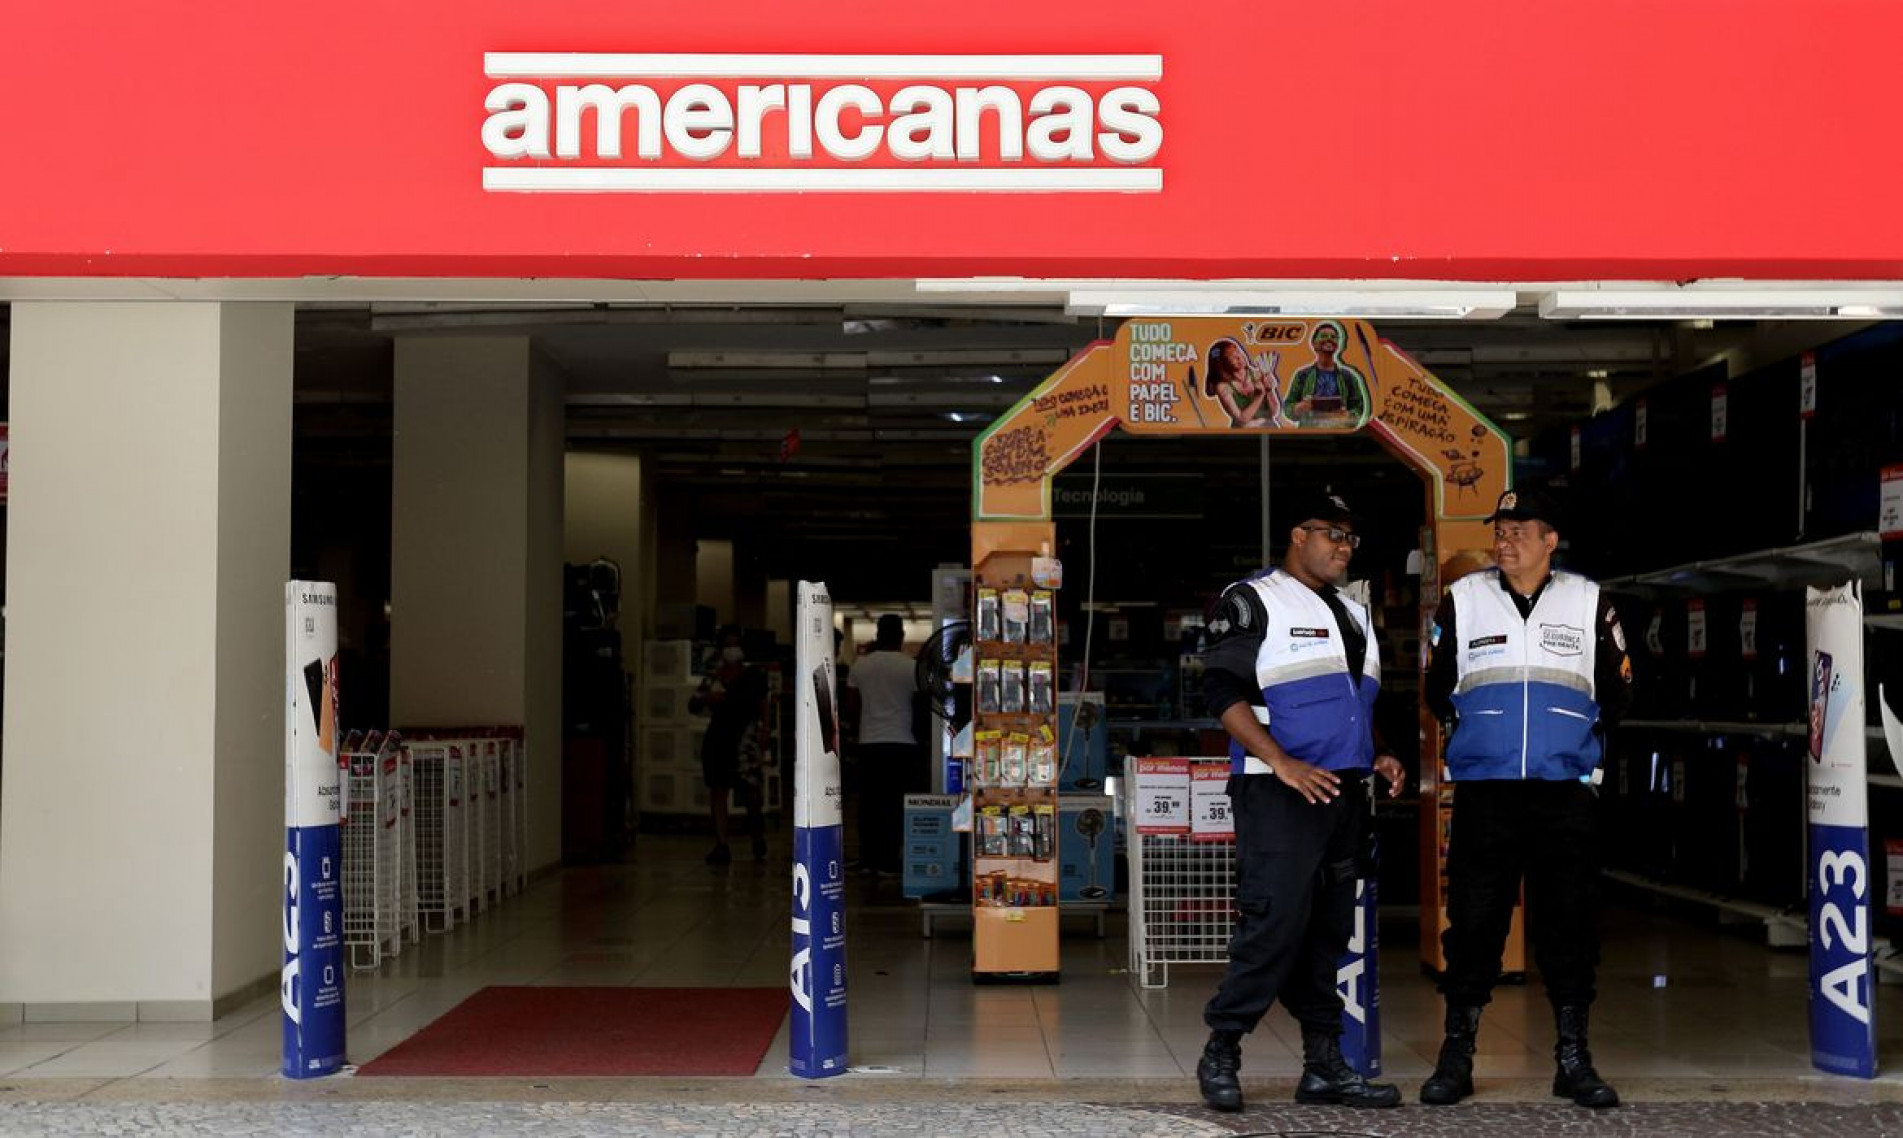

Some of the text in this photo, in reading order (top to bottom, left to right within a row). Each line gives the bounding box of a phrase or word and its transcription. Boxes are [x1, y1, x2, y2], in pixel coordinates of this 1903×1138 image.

[481, 82, 1163, 164] americanas
[1130, 323, 1171, 341] TUDO
[1261, 326, 1301, 339] BIC
[1130, 363, 1166, 381] COM
[1130, 383, 1179, 401] PAPEL
[1130, 403, 1177, 422] E BIC.
[1820, 849, 1868, 1025] A23
